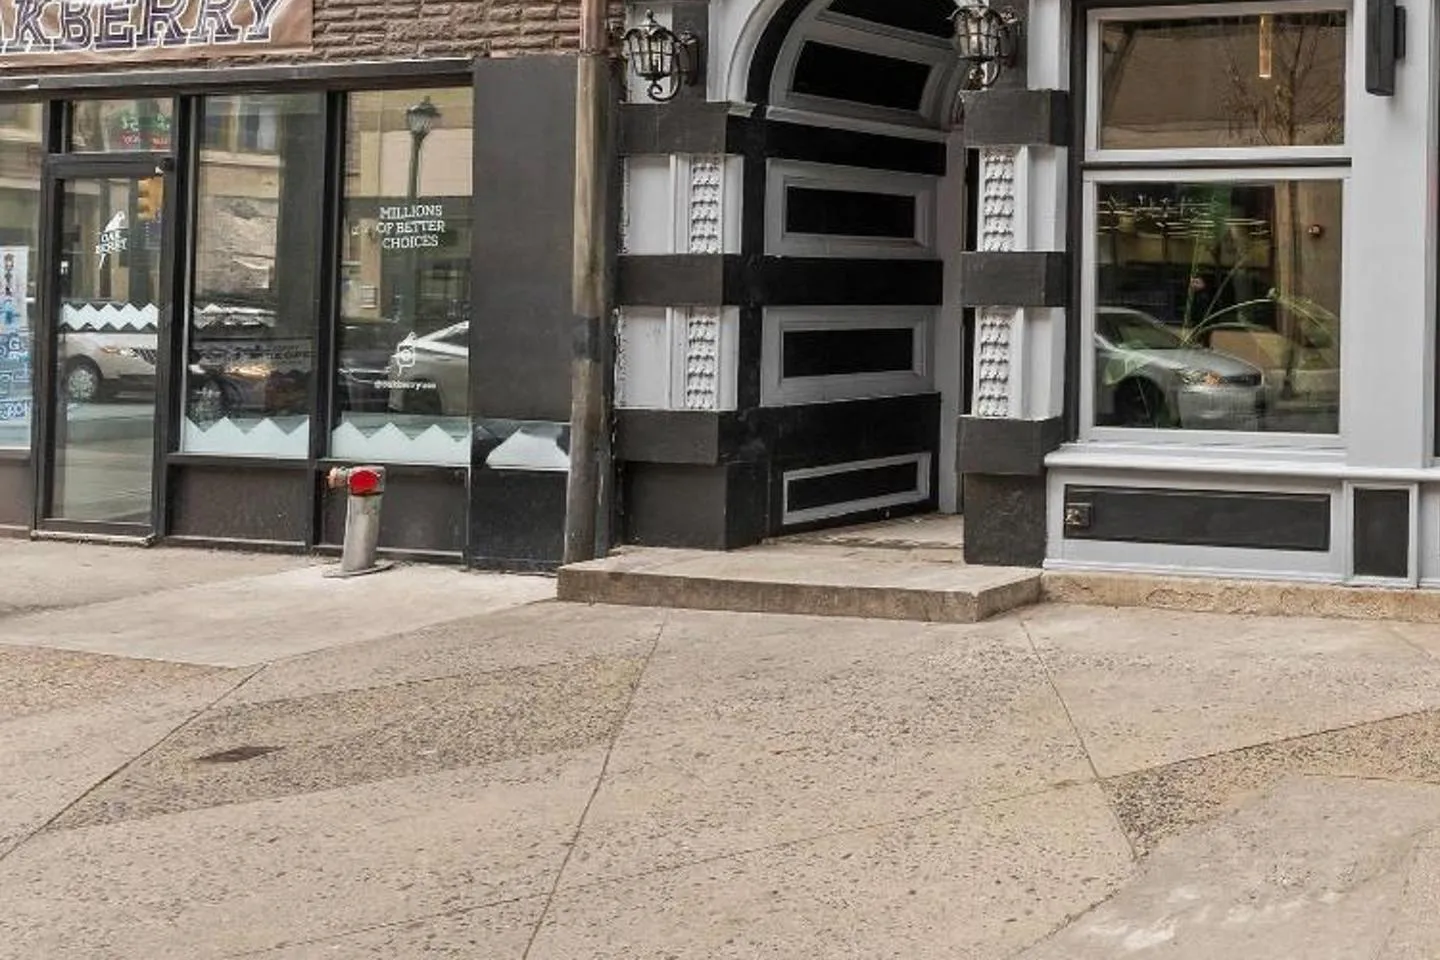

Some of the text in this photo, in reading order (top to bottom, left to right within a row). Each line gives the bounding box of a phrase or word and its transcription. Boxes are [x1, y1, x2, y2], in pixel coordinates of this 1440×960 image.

[380, 205, 443, 220] MILLIONS
[375, 220, 446, 234] OF BETTER
[382, 235, 439, 249] CHOICES
